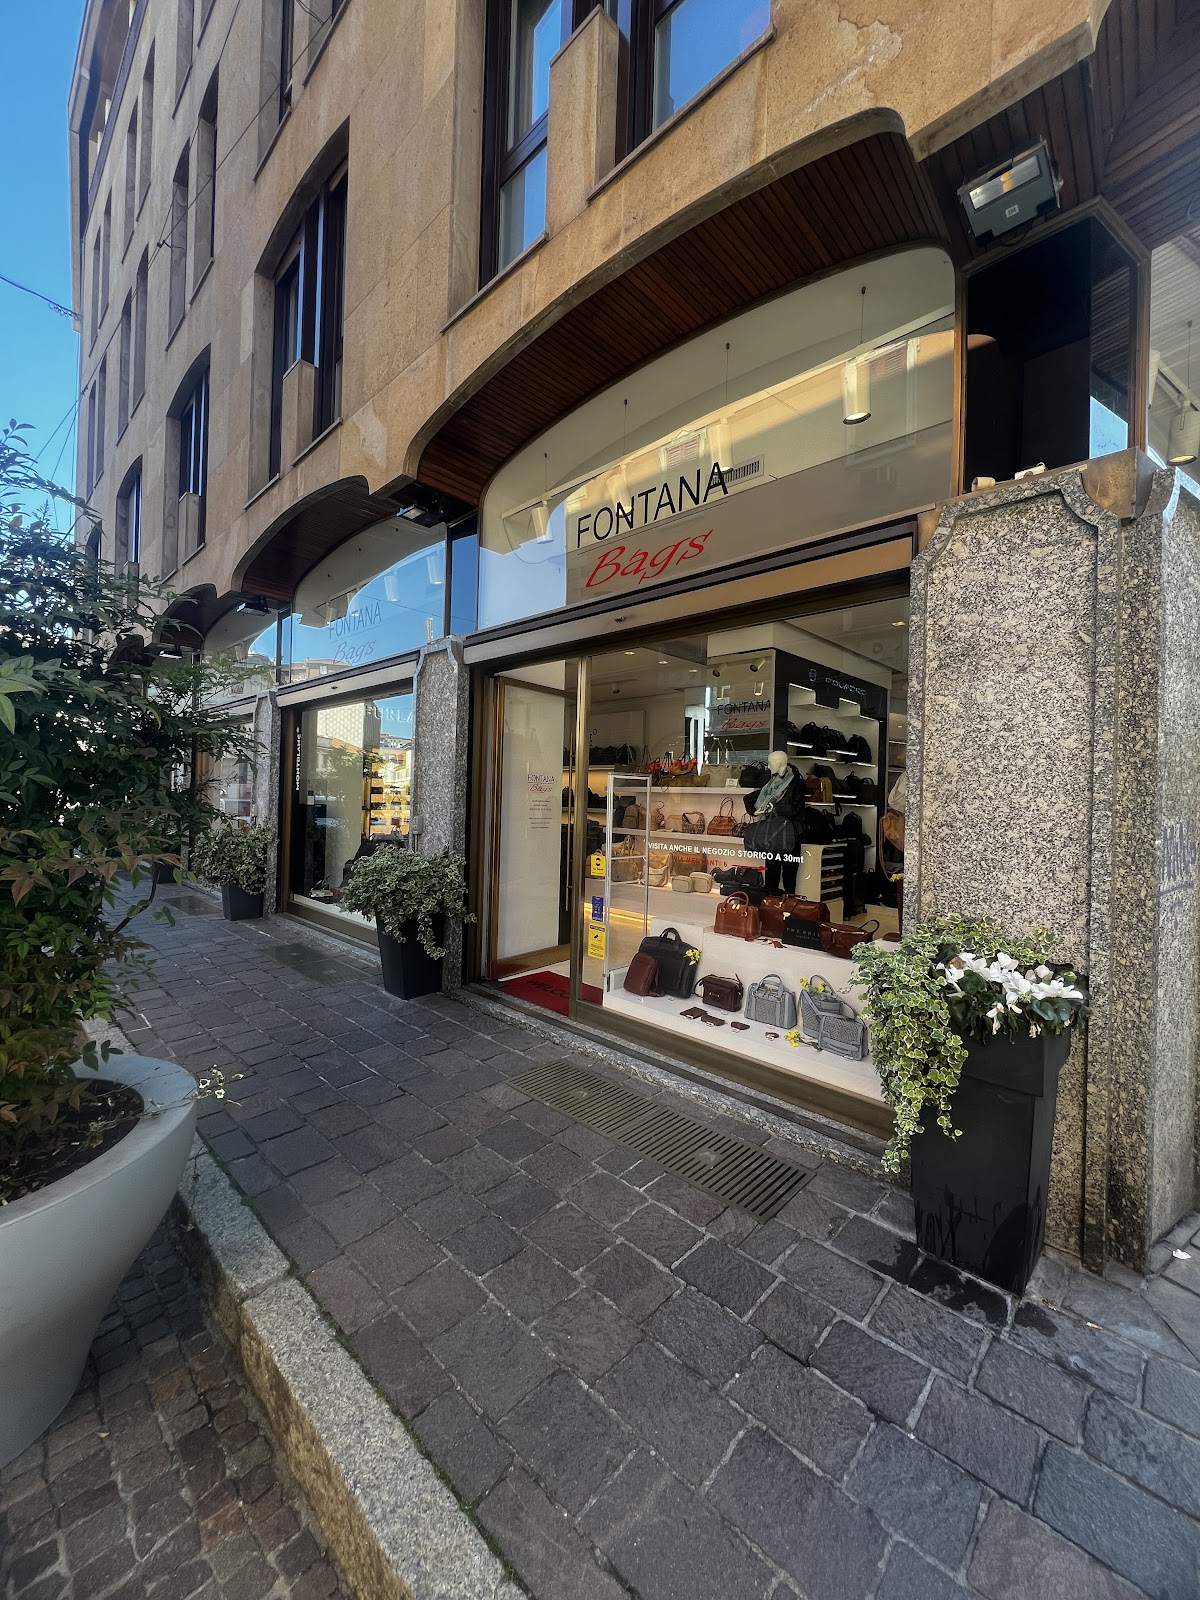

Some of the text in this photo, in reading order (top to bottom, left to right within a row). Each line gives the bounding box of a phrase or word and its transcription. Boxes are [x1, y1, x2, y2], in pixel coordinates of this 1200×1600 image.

[577, 461, 729, 549] FONTANA
[585, 529, 714, 588] Bags
[327, 601, 382, 640] FONTANA
[333, 639, 377, 665] Bags
[717, 700, 771, 716] FONTANA
[722, 718, 768, 731] Bags
[527, 773, 555, 783] FONTANA
[648, 842, 668, 851] VISITA
[669, 843, 693, 853] ANCHE
[702, 847, 736, 857] NEGOZIO
[737, 849, 773, 860] STORICO
[774, 853, 782, 862] A
[783, 853, 805, 864] 30mt
